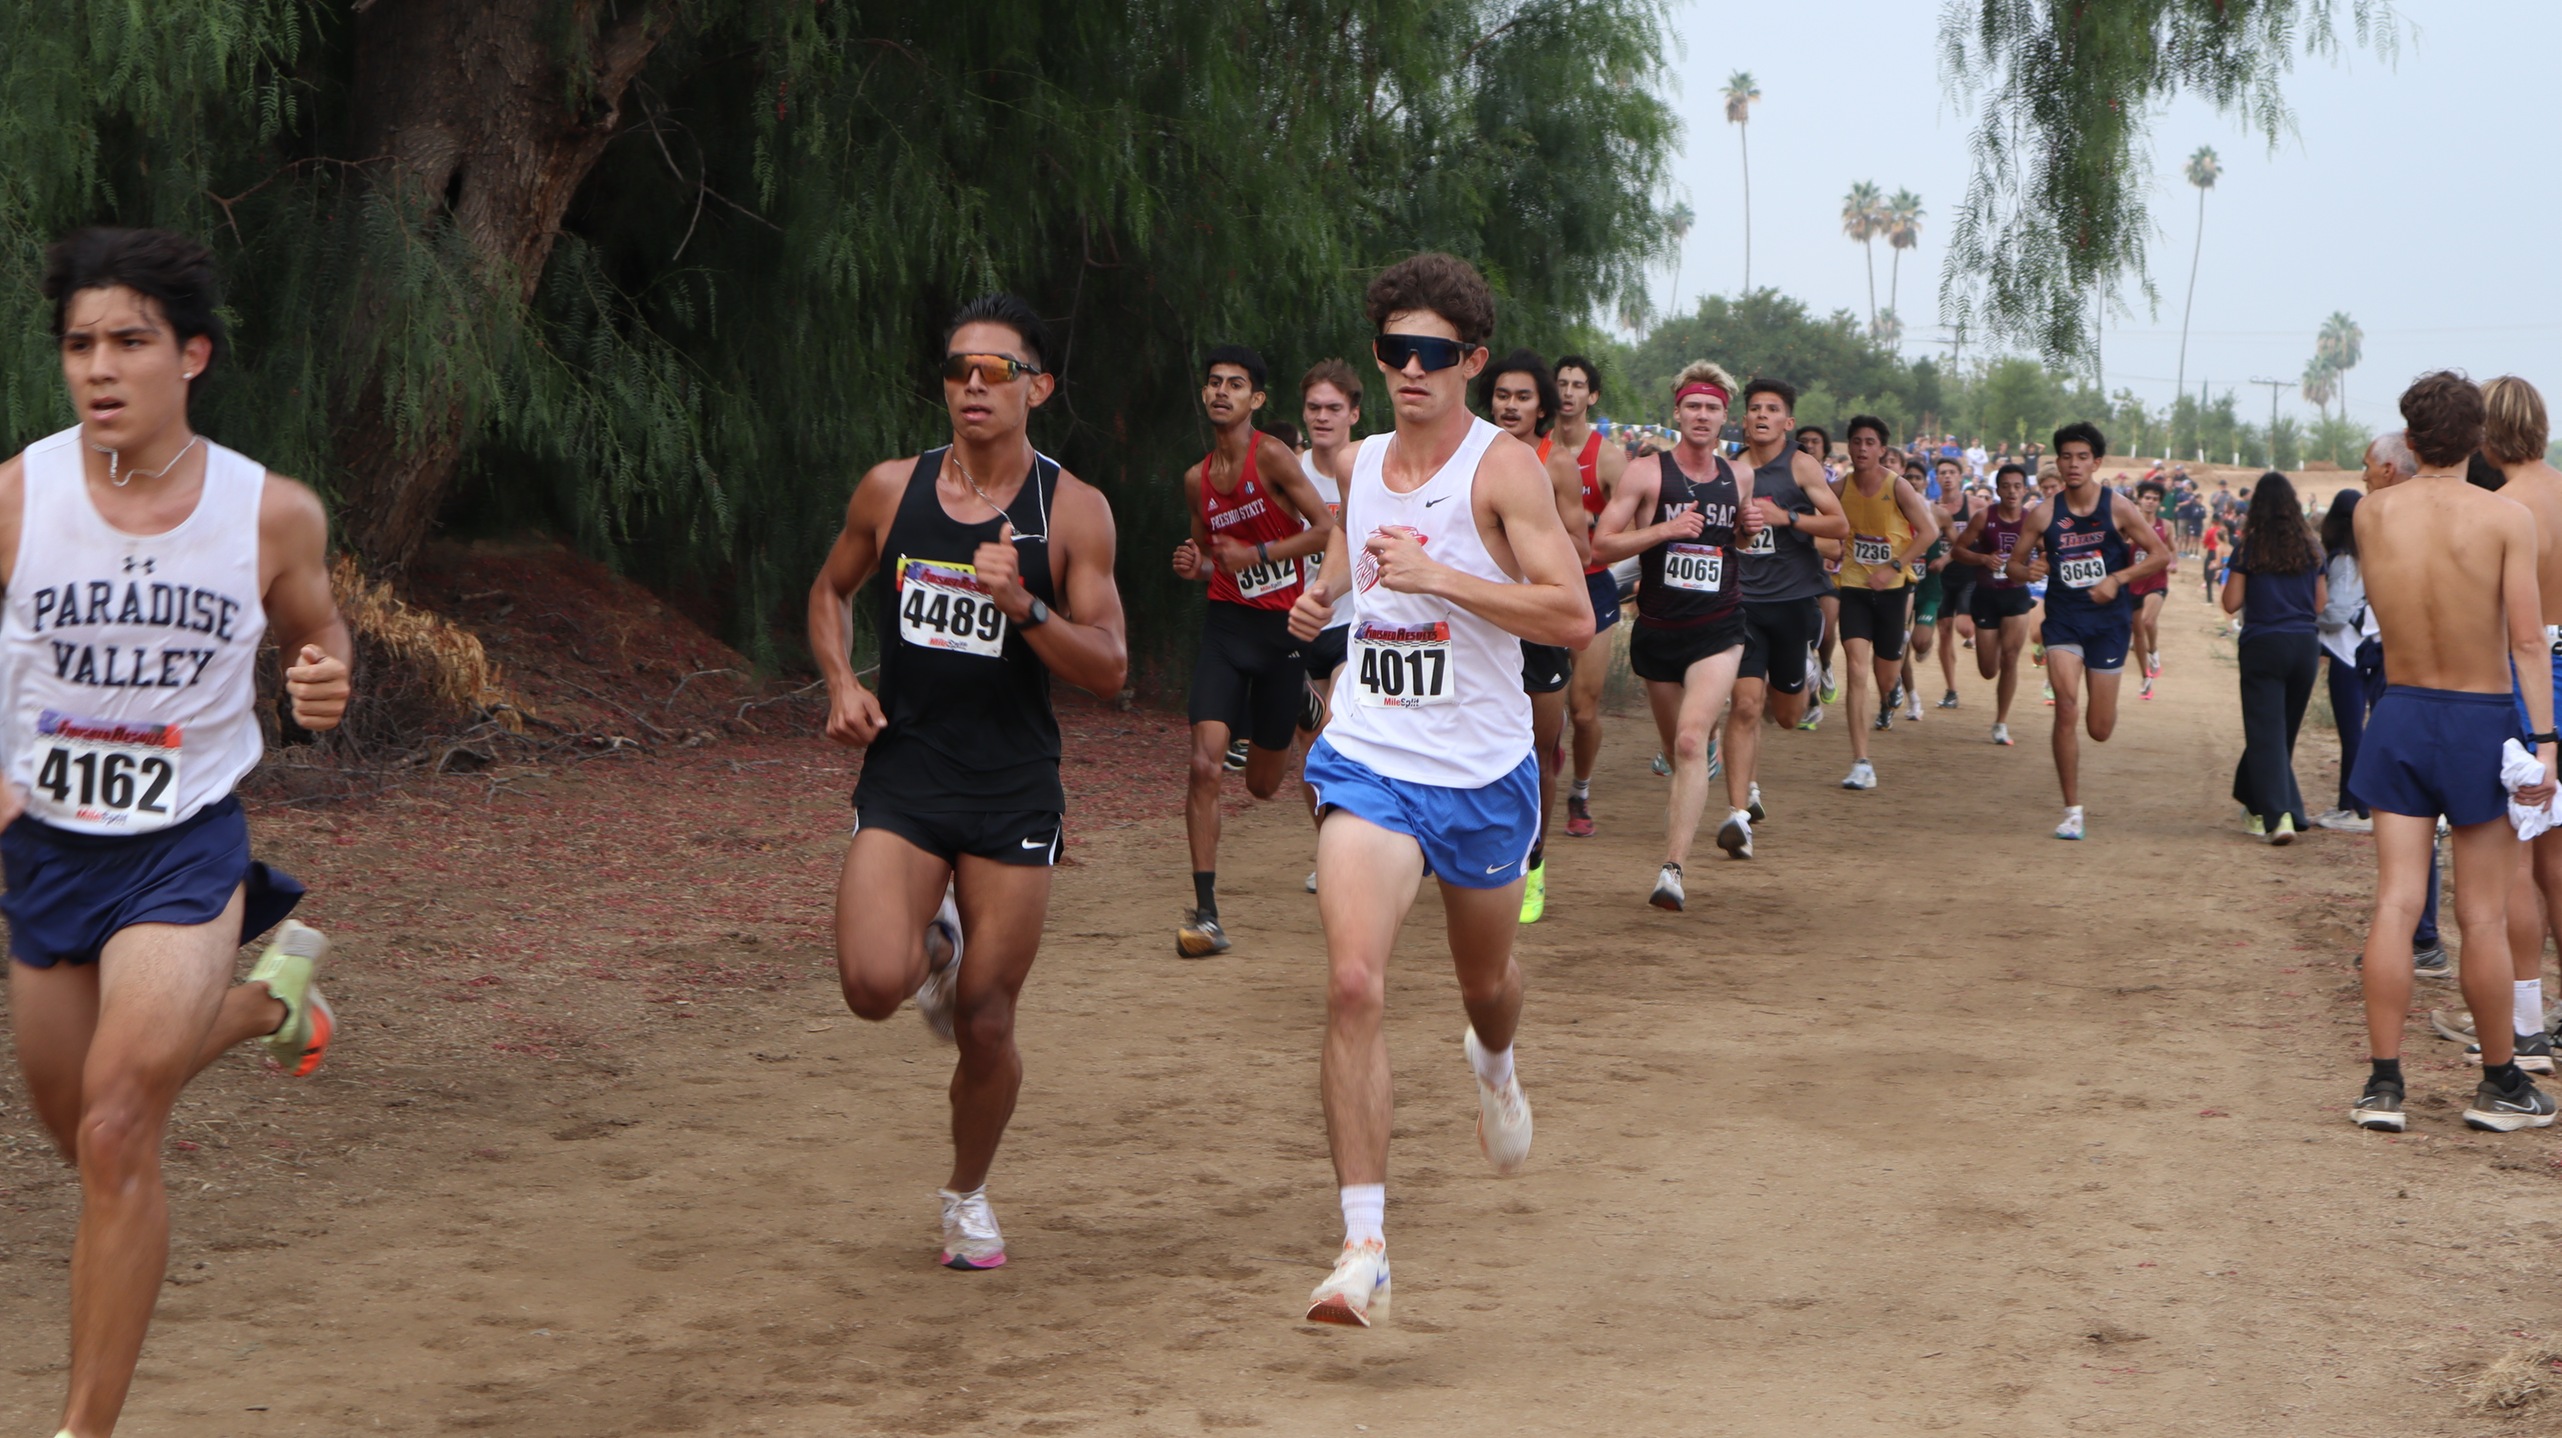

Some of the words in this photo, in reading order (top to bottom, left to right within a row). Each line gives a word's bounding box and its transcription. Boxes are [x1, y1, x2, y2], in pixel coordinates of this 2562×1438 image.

[1209, 509, 1241, 531] FRESNO
[1239, 498, 1267, 520] STATE
[1706, 503, 1737, 528] SAC
[1855, 542, 1890, 560] 7236
[1237, 557, 1295, 590] 3912
[1666, 556, 1720, 582] 4065
[2062, 561, 2103, 582] 3643
[33, 581, 239, 642] PARADISE
[903, 588, 1001, 642] 4489
[52, 641, 216, 687] VALLEY
[1360, 648, 1445, 696] 4017
[1383, 698, 1419, 708] MileSplit
[37, 748, 172, 813] 4162
